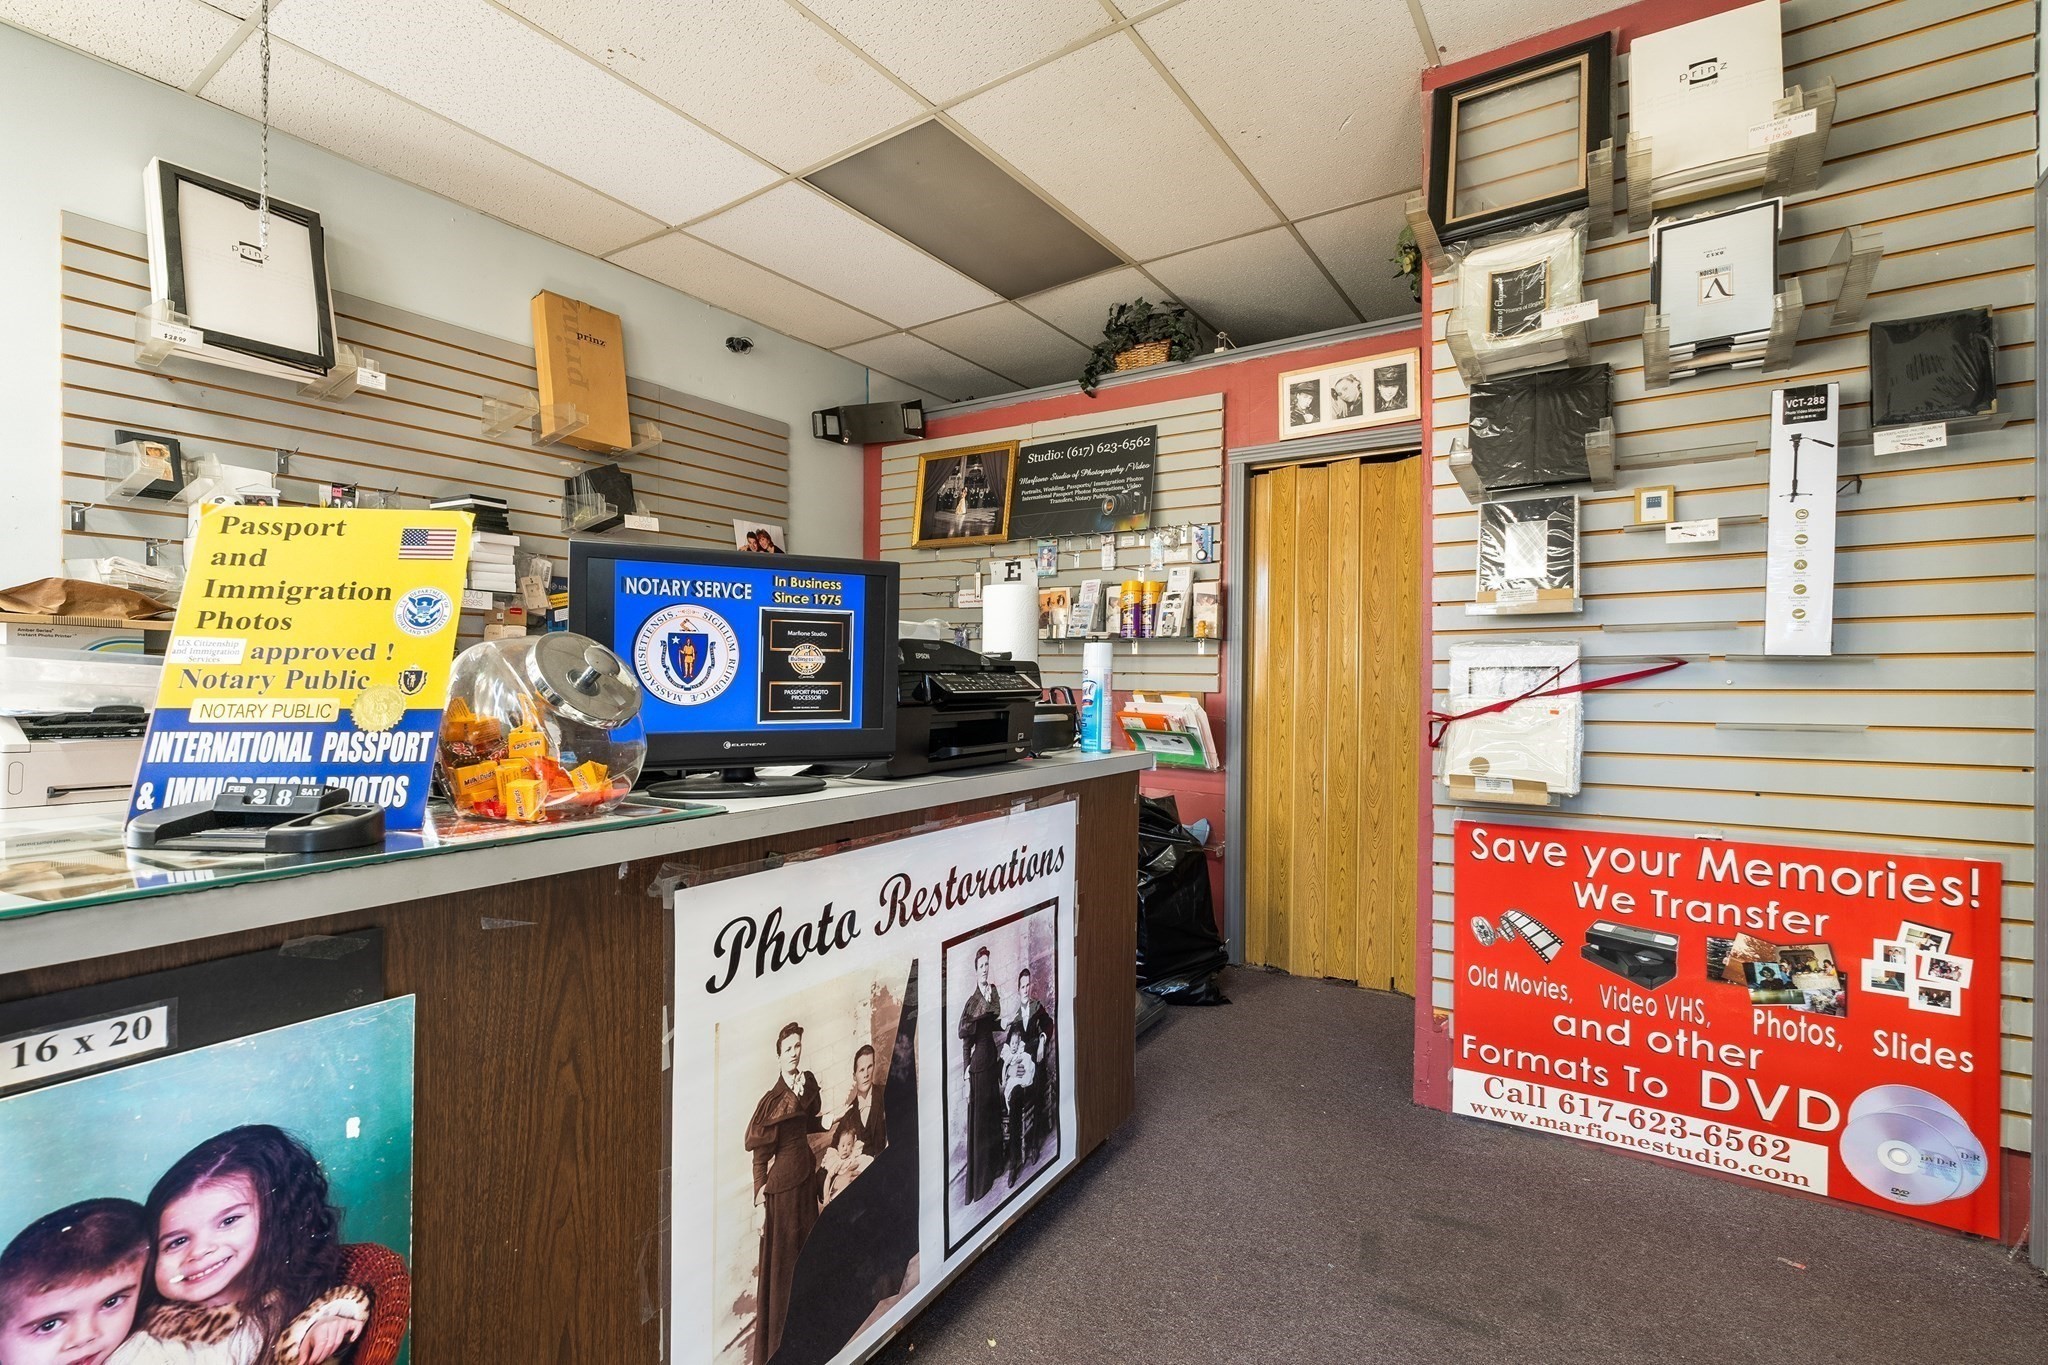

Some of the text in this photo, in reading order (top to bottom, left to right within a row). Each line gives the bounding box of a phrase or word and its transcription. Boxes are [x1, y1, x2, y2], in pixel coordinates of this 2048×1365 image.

[1679, 61, 1728, 83] prinz
[231, 244, 271, 262] prinz
[555, 300, 590, 391] prinz
[576, 331, 606, 347] prinz
[1785, 396, 1826, 408] VCT-288
[1027, 435, 1151, 464] Studio: (617) 623-6562
[1049, 472, 1072, 481] Studio
[1071, 469, 1080, 480] of
[1080, 464, 1125, 477] Photography
[218, 514, 347, 541] Passport
[210, 548, 268, 568] and
[1004, 561, 1021, 582] E
[201, 578, 393, 606] Immigration
[624, 577, 753, 599] NOTARY SERVCE
[774, 575, 842, 591] In Business
[774, 591, 842, 606] Since 1975
[195, 610, 293, 631] Photos
[702, 612, 736, 652] SIGILLUM
[172, 647, 240, 657] and Immigration
[177, 639, 240, 649] U.S. Citizenship
[250, 643, 395, 665] approved !
[915, 652, 930, 660] EPSON
[188, 655, 221, 663] Services
[177, 668, 371, 695] Notary Public
[199, 703, 333, 719] NOTARY PUBLIC
[147, 731, 434, 763] INTERNATIONAL PASSPORT
[300, 788, 320, 796] SAT
[464, 770, 496, 787] Milk Duds
[136, 782, 155, 810] &
[1470, 828, 1981, 908] Save your Memories!
[704, 844, 1066, 994] Photo Restorations
[1573, 881, 1830, 936] We Transfer
[1468, 964, 1574, 1005] Old Movies,
[1599, 984, 1712, 1029] Video VHS,
[10, 1015, 152, 1069] 16 x 20
[1553, 1014, 1764, 1070] and other
[1753, 1008, 1843, 1053] Photos,
[1872, 1029, 1975, 1073] Slides
[1462, 1034, 1841, 1132] Formats To DVD
[1484, 1076, 1791, 1164] Call 617-623-6562
[1470, 1102, 1811, 1188] www.marfionestudio.com
